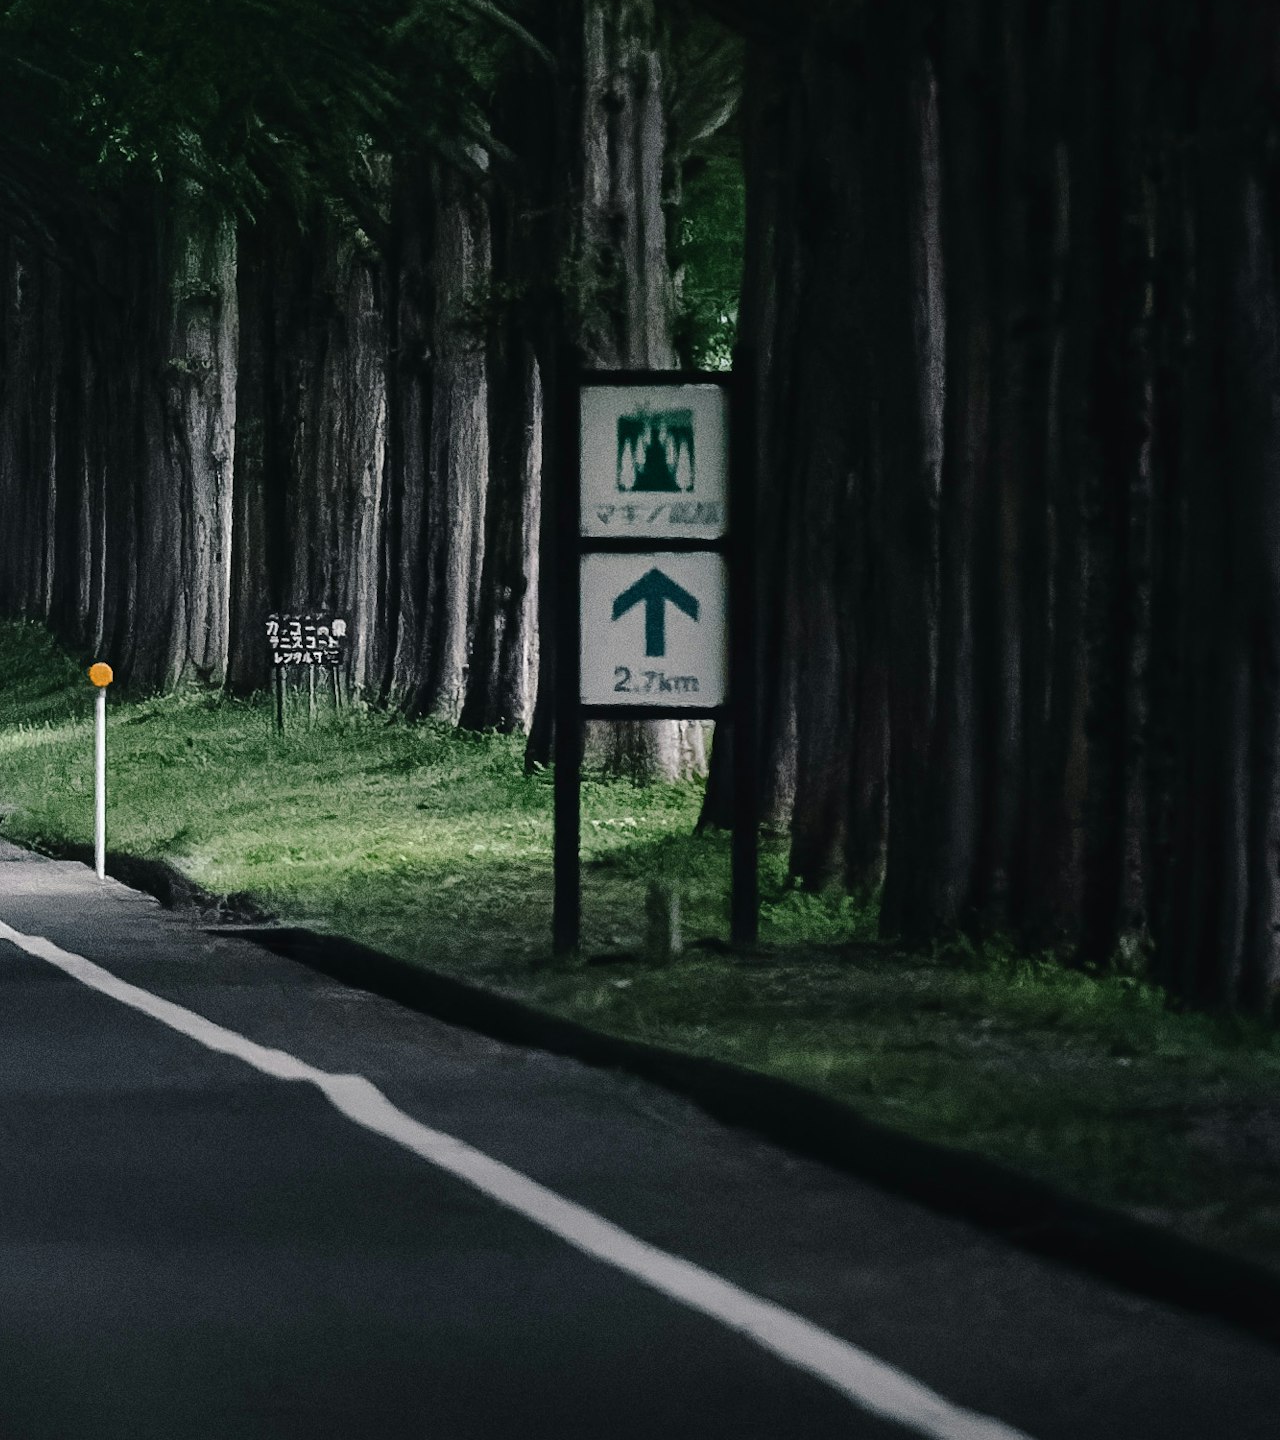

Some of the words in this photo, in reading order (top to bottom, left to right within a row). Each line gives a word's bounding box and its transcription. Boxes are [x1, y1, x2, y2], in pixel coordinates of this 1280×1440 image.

[594, 501, 724, 524] マキノ
[614, 666, 700, 693] 2.7km
